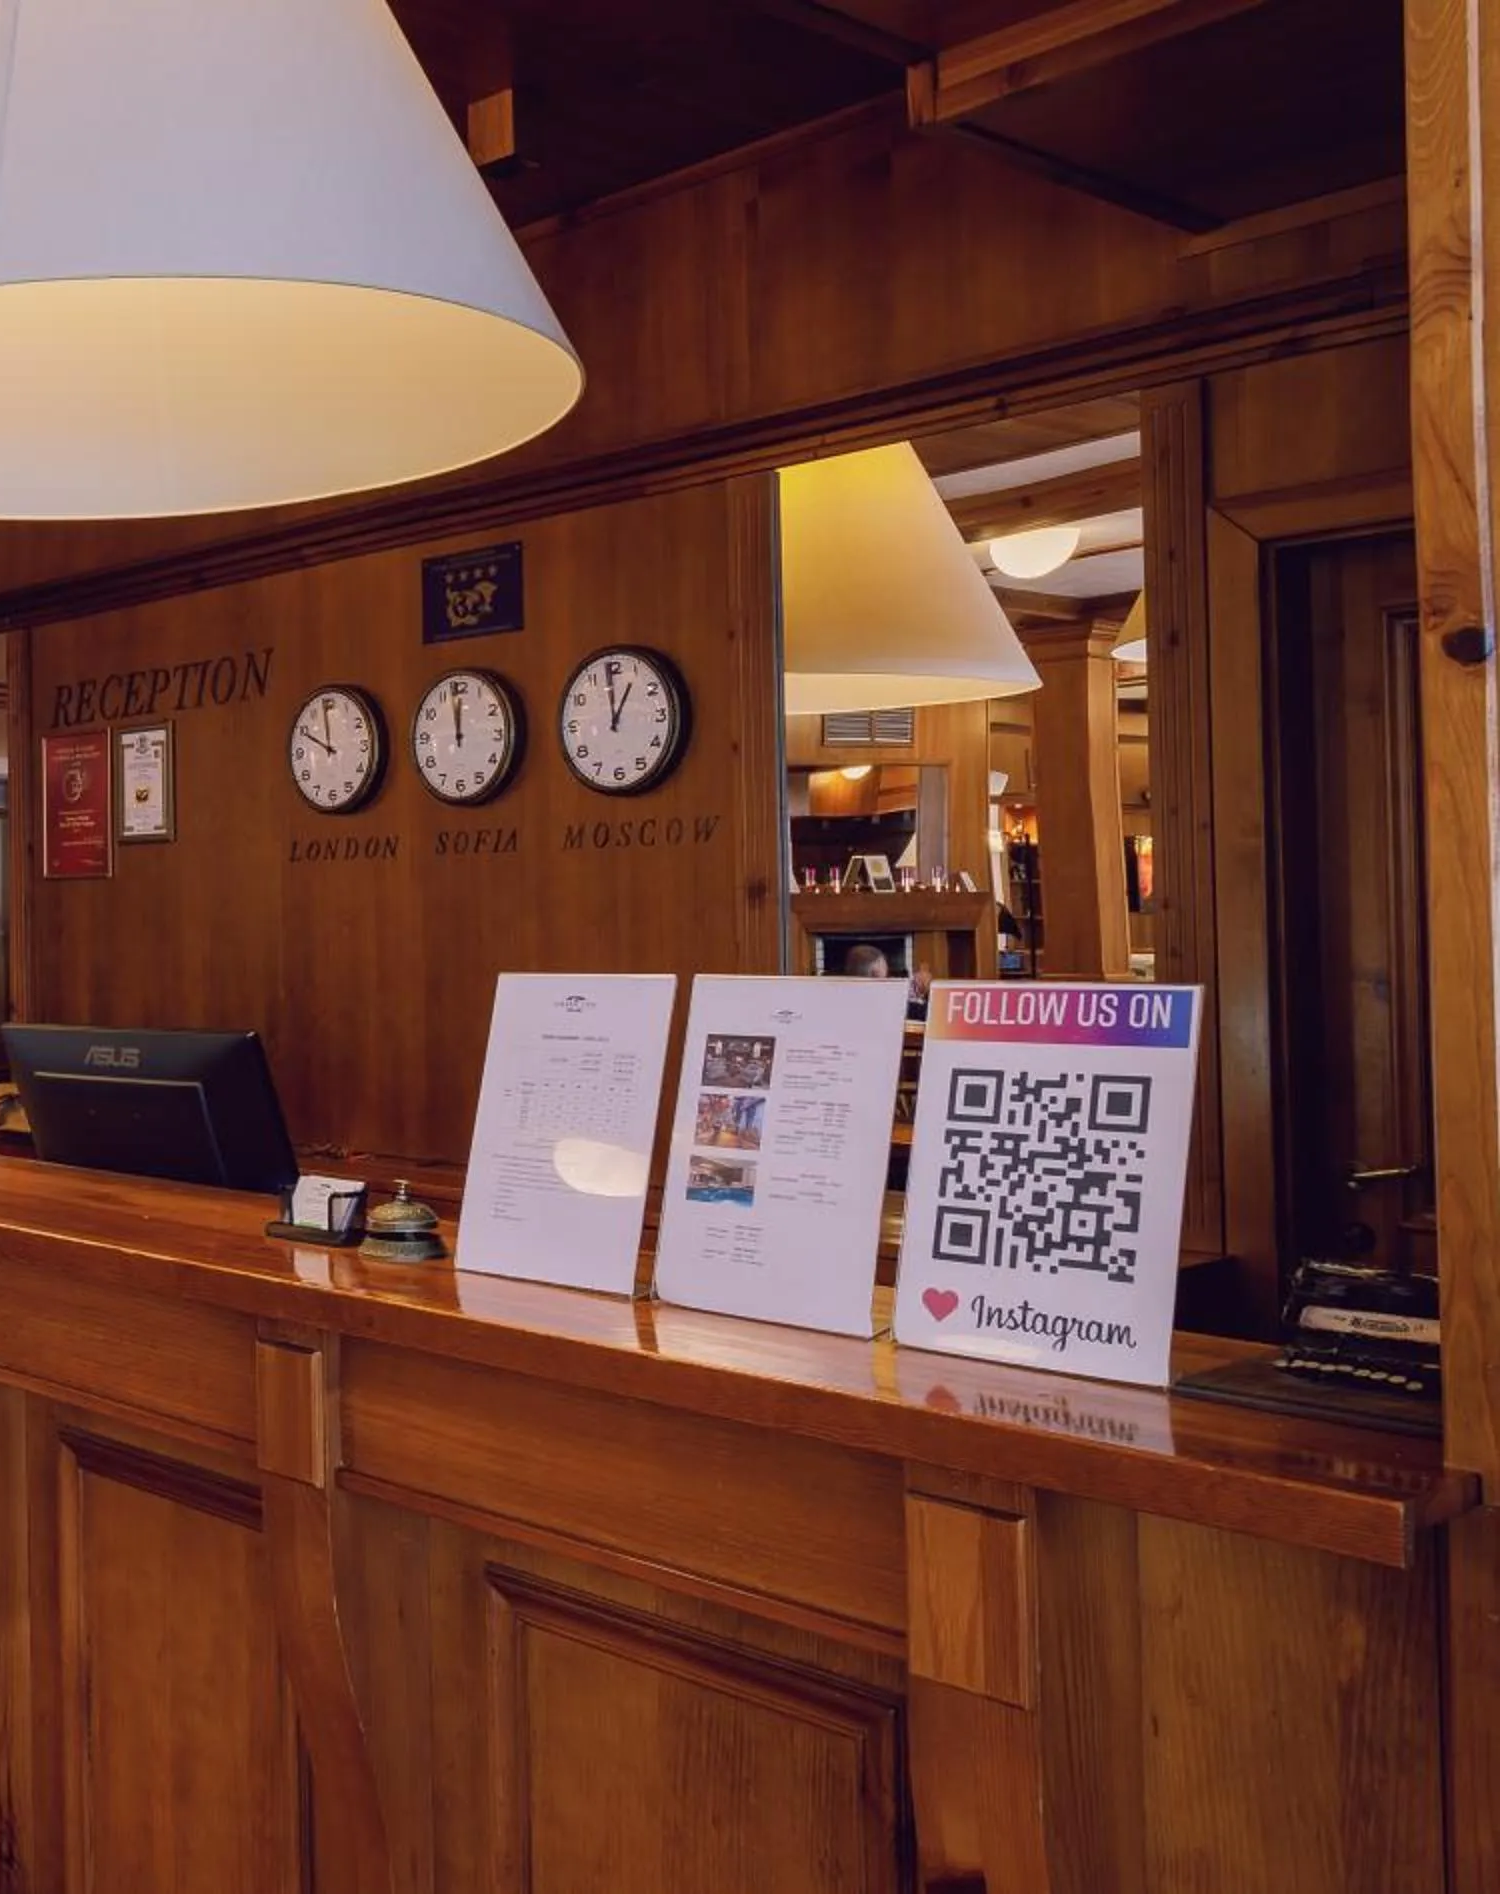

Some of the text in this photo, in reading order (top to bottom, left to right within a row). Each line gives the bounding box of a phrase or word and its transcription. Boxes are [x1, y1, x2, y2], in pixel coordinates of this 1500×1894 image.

[605, 661, 622, 675] 2
[51, 647, 274, 729] RECEPTION
[646, 682, 659, 697] 2
[573, 694, 587, 707] 10
[425, 707, 437, 721] 10
[488, 703, 498, 717] 2
[655, 708, 667, 723] 3
[355, 716, 364, 730] 2
[419, 731, 431, 745] 9
[493, 728, 503, 742] 3
[650, 735, 661, 749] 4
[360, 739, 369, 752] 3
[576, 745, 589, 759] 8
[295, 747, 305, 760] 9
[488, 752, 498, 765] 4
[356, 762, 365, 774] 4
[425, 755, 437, 769] 8
[635, 757, 647, 771] 5
[301, 769, 311, 781] 8
[592, 762, 603, 777] 7
[613, 767, 626, 781] 6
[438, 773, 448, 787] 7
[474, 771, 485, 785] 5
[313, 784, 321, 797] 7
[344, 781, 354, 794] 5
[455, 779, 467, 793] 6
[328, 789, 338, 801] 6
[562, 815, 721, 850] MOSCOW
[435, 827, 518, 855] SOFIA
[288, 834, 400, 863] LONDON
[947, 991, 1173, 1029] FOLLOW US ON
[84, 1045, 141, 1069] ASUS
[971, 1295, 1137, 1352] Instagram
